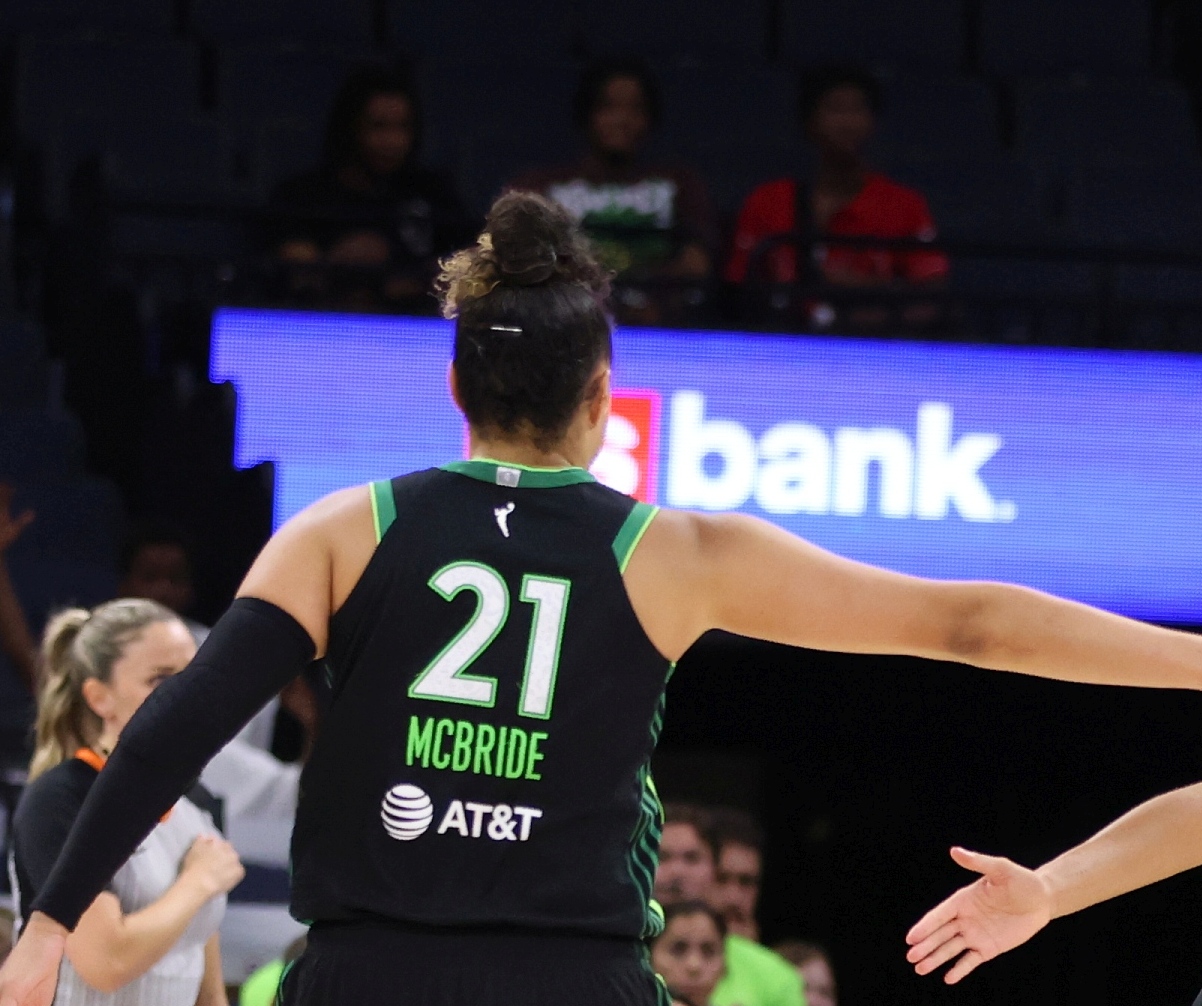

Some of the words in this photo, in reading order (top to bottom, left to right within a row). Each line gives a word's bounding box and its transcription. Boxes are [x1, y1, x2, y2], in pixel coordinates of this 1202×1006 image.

[589, 414, 641, 496] s
[407, 560, 571, 720] 21
[406, 715, 549, 780] MCBRIDE
[437, 799, 543, 842] AT&T
